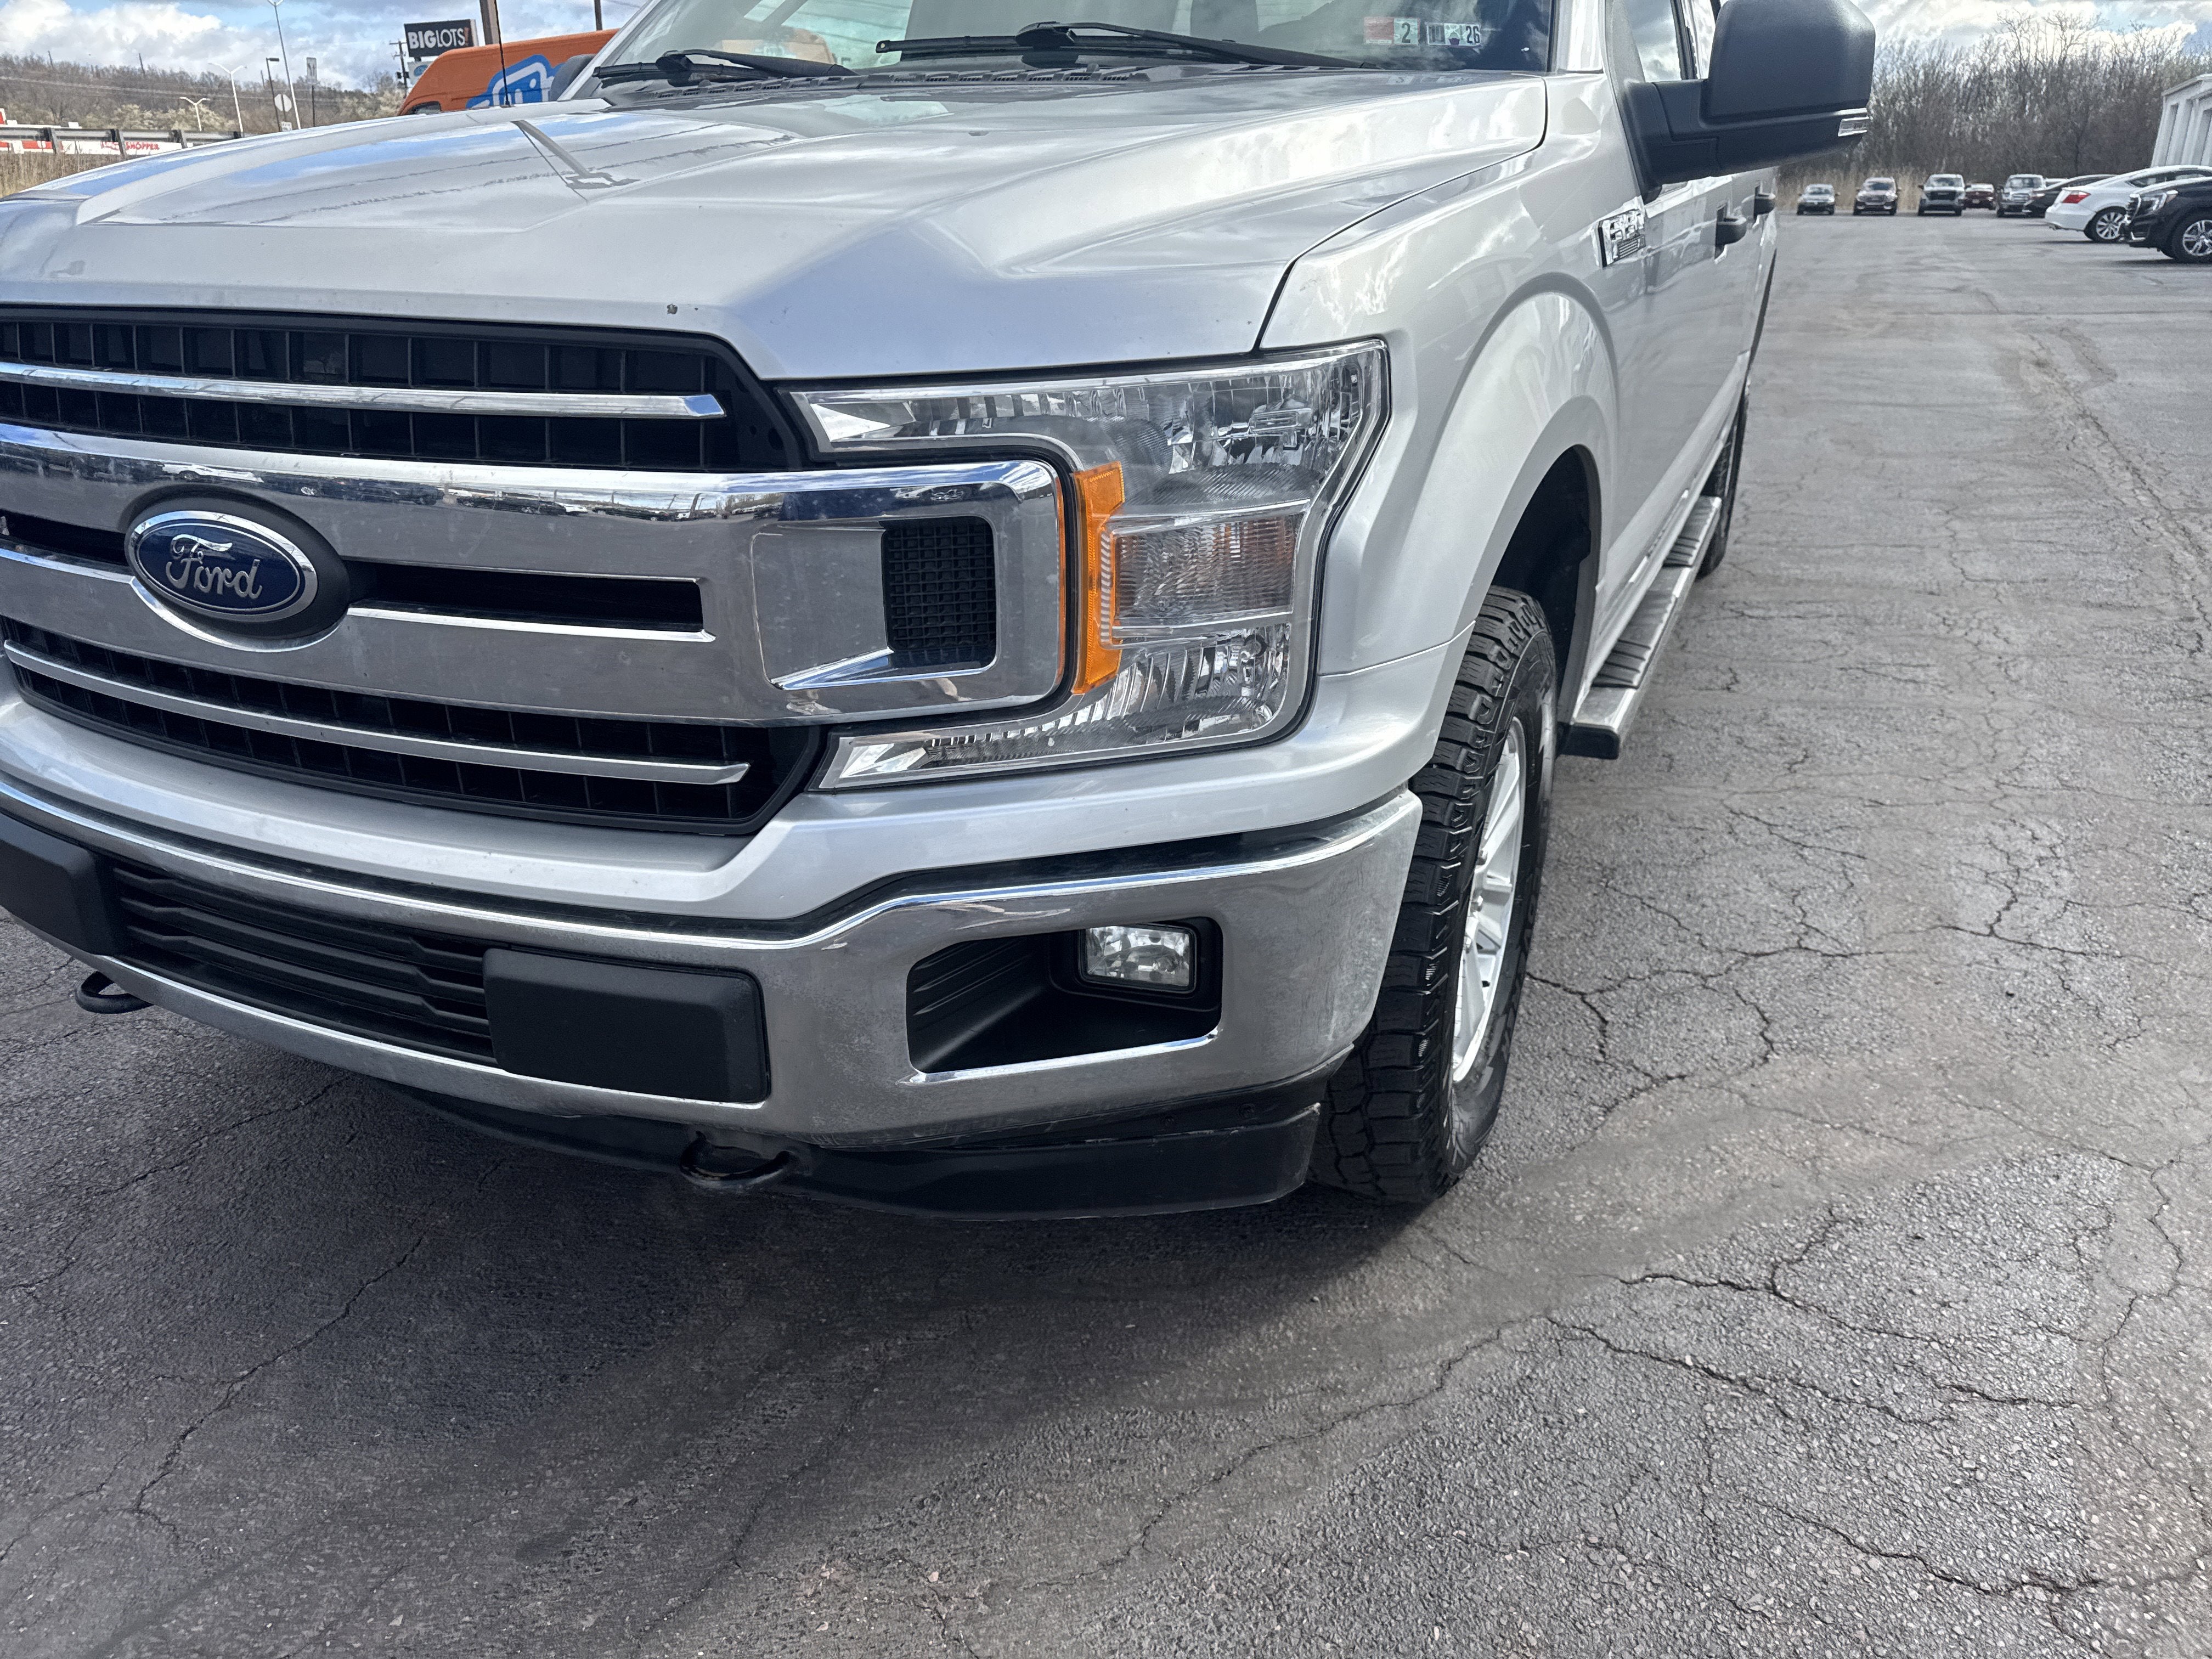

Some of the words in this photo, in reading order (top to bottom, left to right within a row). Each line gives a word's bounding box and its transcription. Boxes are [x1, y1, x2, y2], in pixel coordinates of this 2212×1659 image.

[1402, 21, 1411, 43] 2
[1465, 25, 1480, 43] 26
[166, 534, 263, 599] Ford
